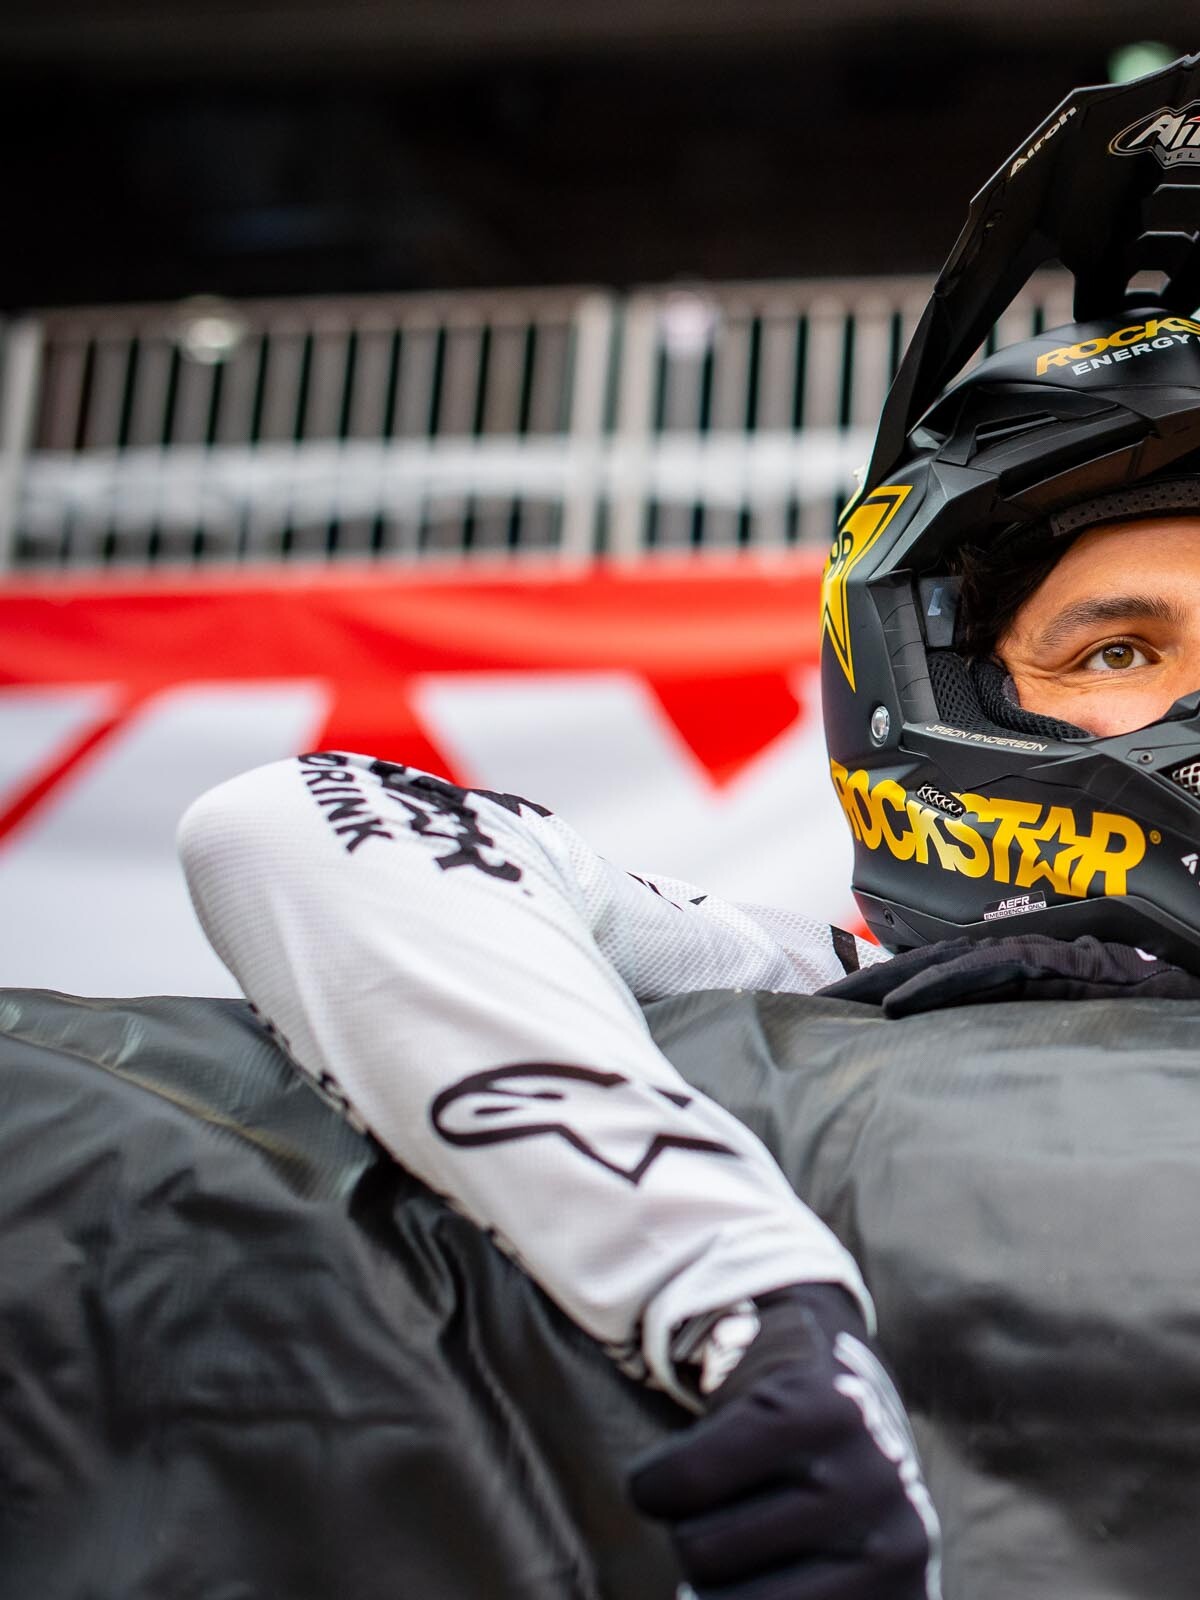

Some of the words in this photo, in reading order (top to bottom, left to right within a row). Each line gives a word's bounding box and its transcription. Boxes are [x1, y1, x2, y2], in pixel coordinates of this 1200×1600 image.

[1071, 333, 1191, 376] ENERGY
[925, 725, 971, 740] JASON
[968, 733, 1048, 752] ANDERSON
[998, 896, 1030, 911] AEFR
